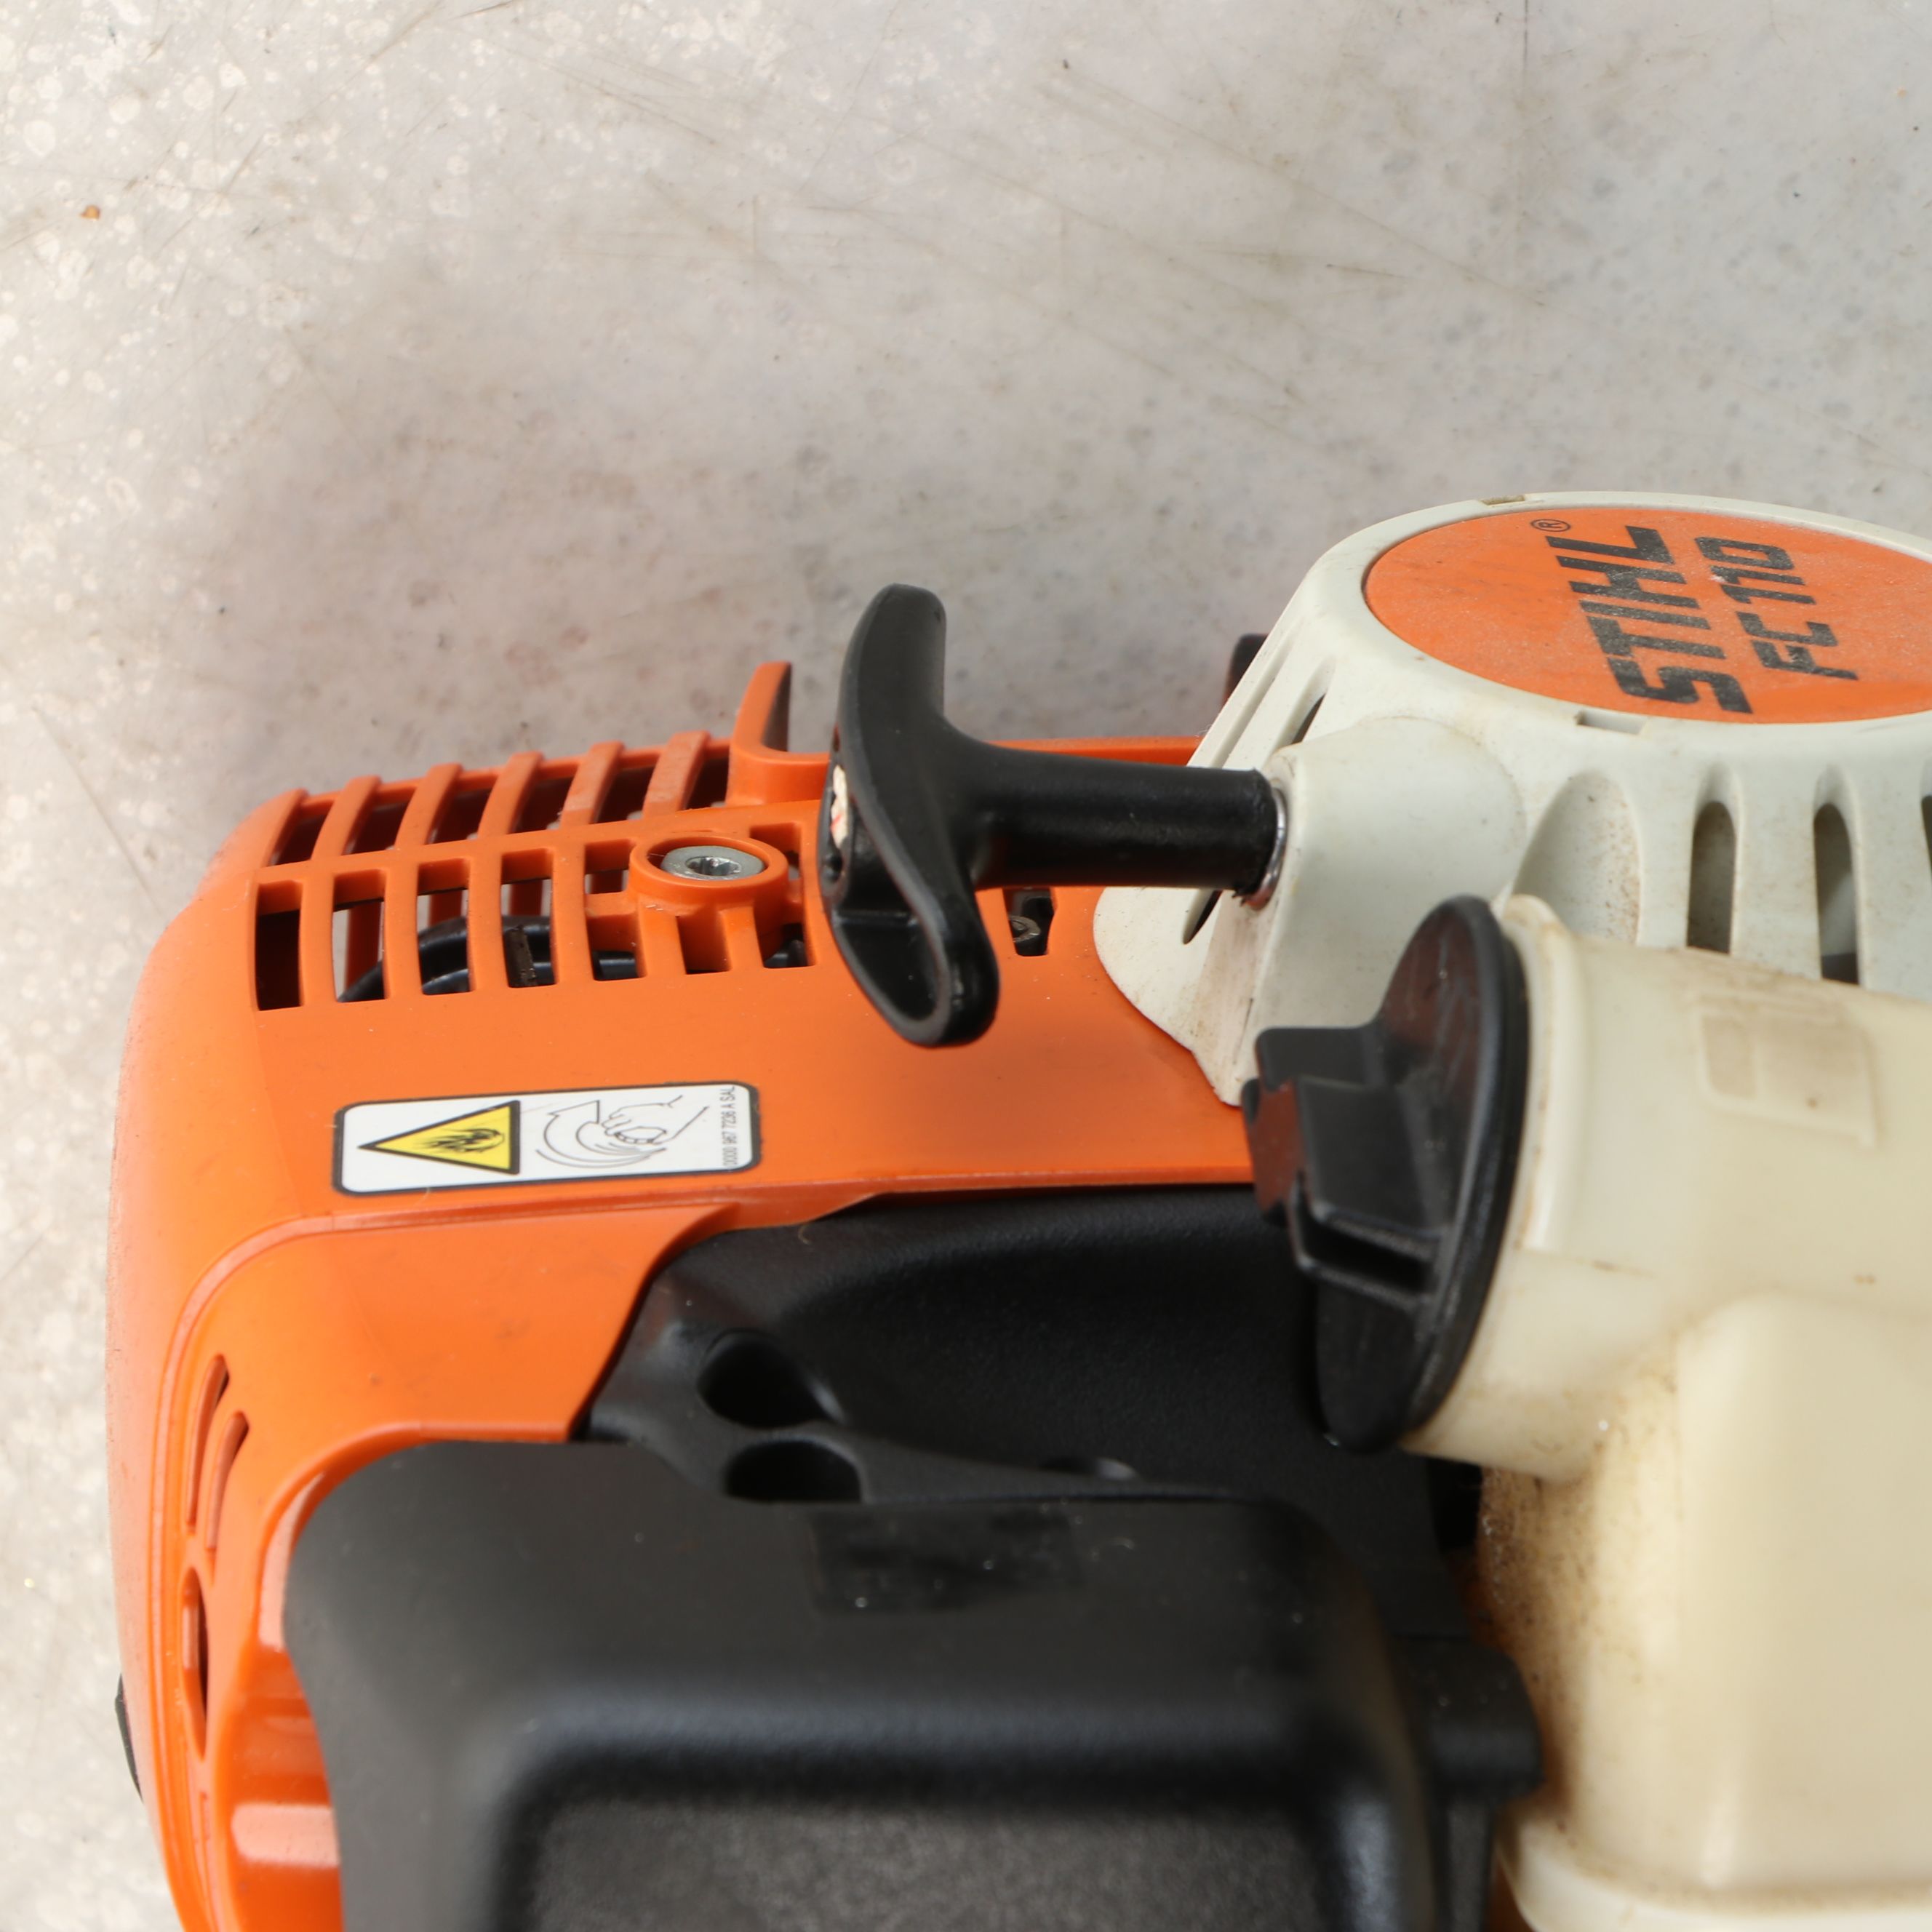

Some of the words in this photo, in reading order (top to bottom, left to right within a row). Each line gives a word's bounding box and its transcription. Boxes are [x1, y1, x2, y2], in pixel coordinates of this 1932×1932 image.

[1695, 536, 1817, 604] 110
[1545, 525, 1753, 714] STIHL
[1736, 611, 1859, 680] FC
[719, 1085, 735, 1101] SAL
[722, 1147, 738, 1166] 0000
